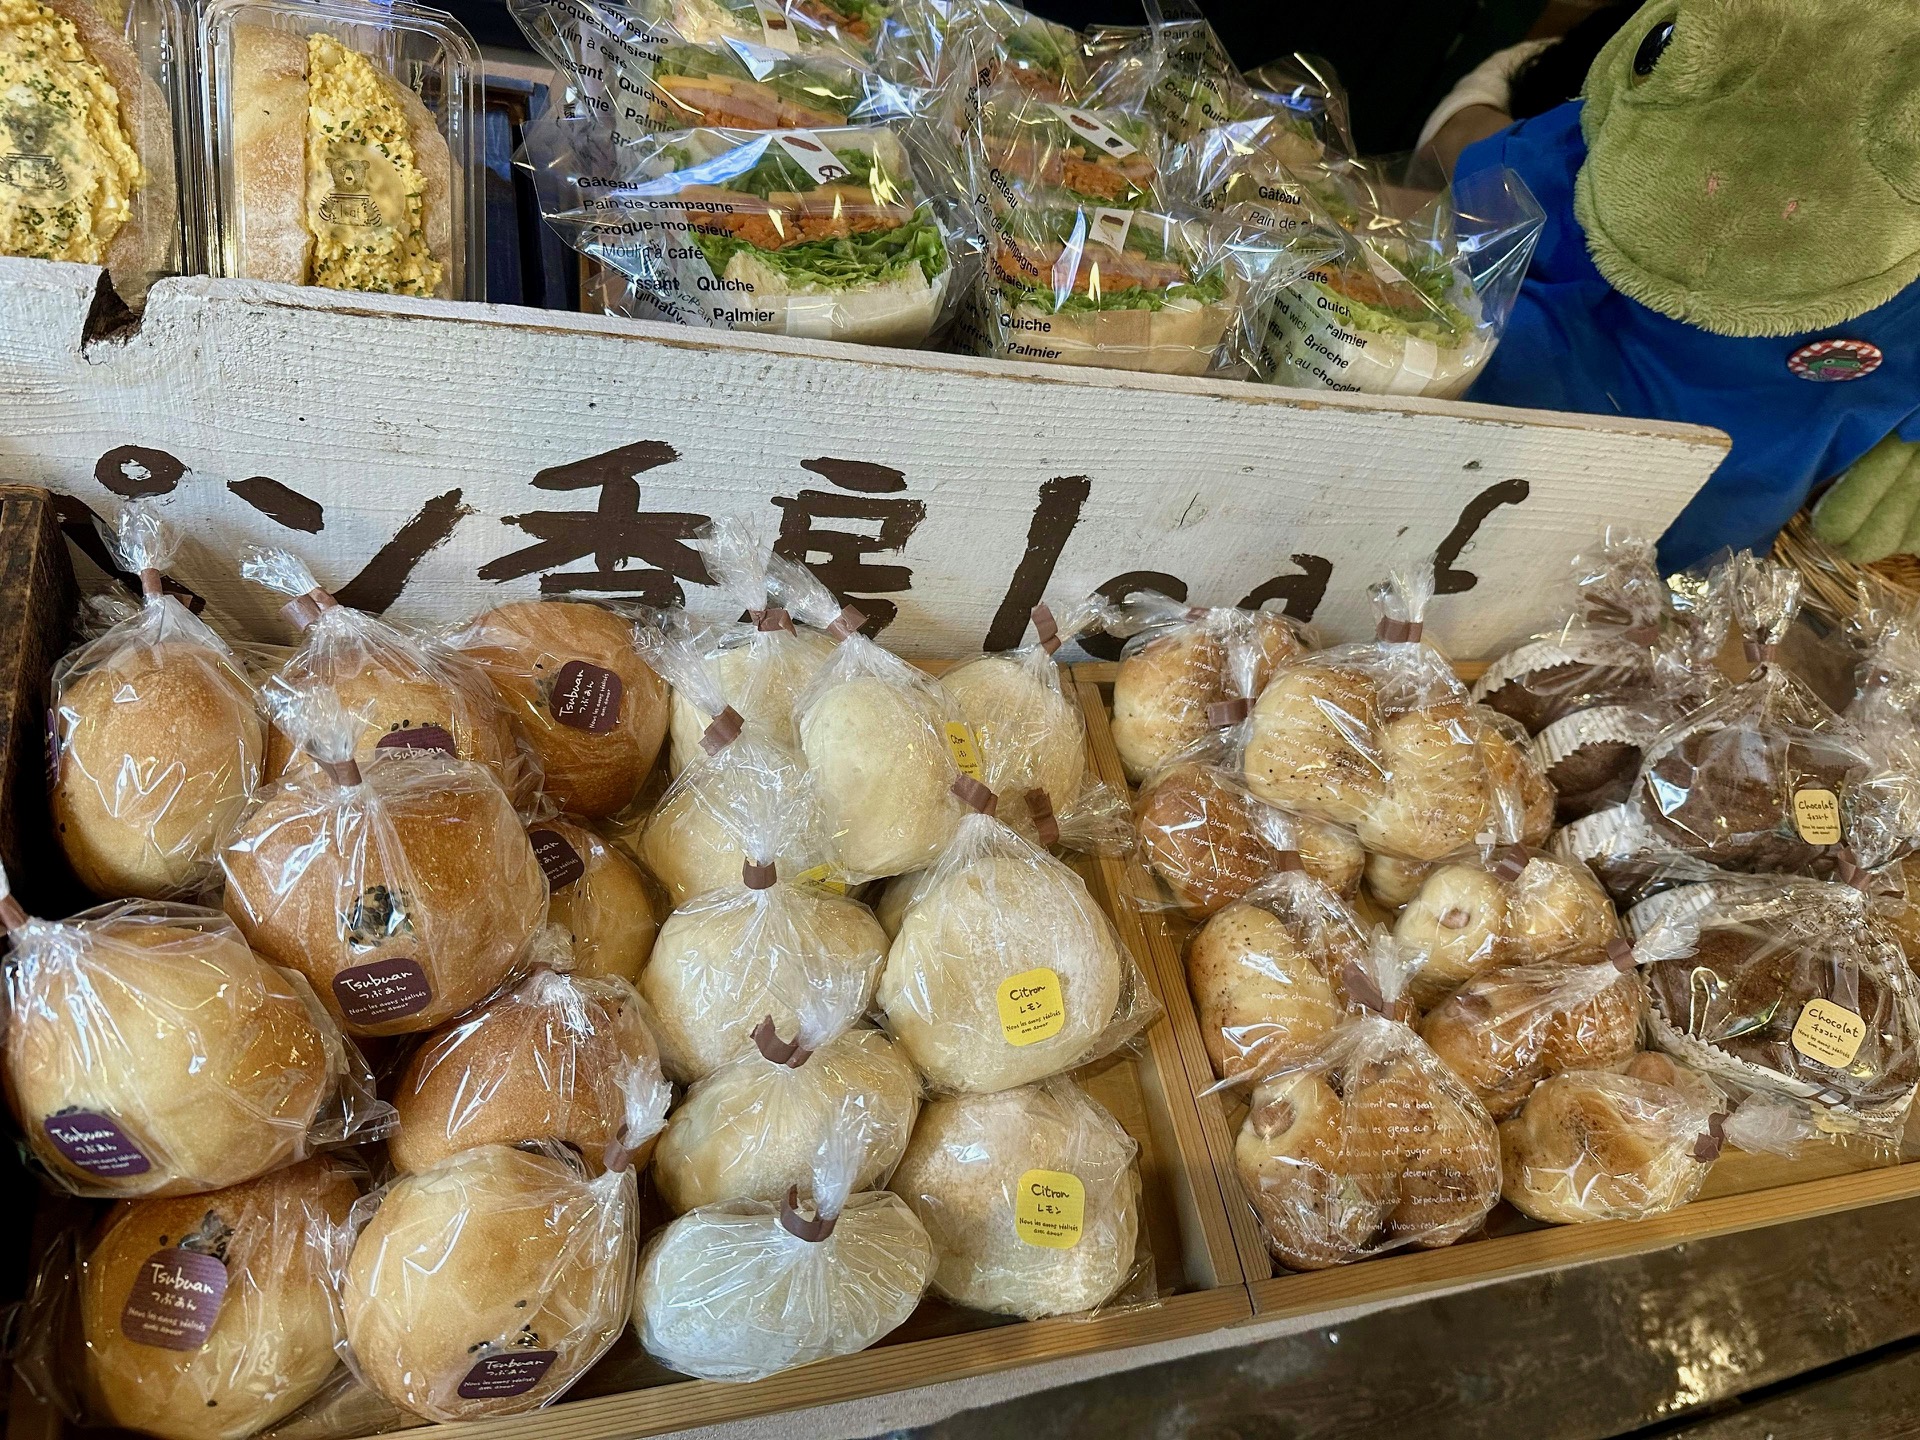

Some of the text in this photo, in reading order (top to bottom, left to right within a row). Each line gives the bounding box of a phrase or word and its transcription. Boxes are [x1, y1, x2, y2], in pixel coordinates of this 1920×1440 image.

[540, 0, 664, 64] roque-monsieur
[618, 76, 669, 109] Quiche
[577, 176, 639, 191] Gâteau
[990, 168, 1018, 210] Gâteau
[583, 197, 735, 214] Pain de campagne
[1258, 186, 1301, 206] Gâteau
[591, 219, 735, 239] Croque-monsieur
[1248, 211, 1297, 231] Pain de
[668, 245, 704, 260] café
[1001, 230, 1039, 277] campagne
[696, 276, 755, 293] Quiche
[713, 307, 775, 323] Palmier
[1000, 313, 1052, 333] Quiche
[1007, 343, 1062, 359] Palmier
[1304, 334, 1349, 369] Brioche
[559, 669, 584, 717] Tsubuan
[1798, 800, 1834, 810] Chocolat
[340, 972, 413, 992] Tsubuan
[359, 985, 407, 999] つぶあん
[1009, 985, 1046, 1001] Citron
[1019, 1001, 1042, 1014] レモン
[1808, 1008, 1859, 1038] Chocolat
[1811, 1023, 1844, 1043] チョコレート
[1031, 1183, 1070, 1199] Citron
[1037, 1203, 1062, 1215] レモン
[151, 1263, 214, 1294] Tsubuan
[152, 1291, 197, 1311] つぶあん
[485, 1358, 544, 1370] Tsubuan
